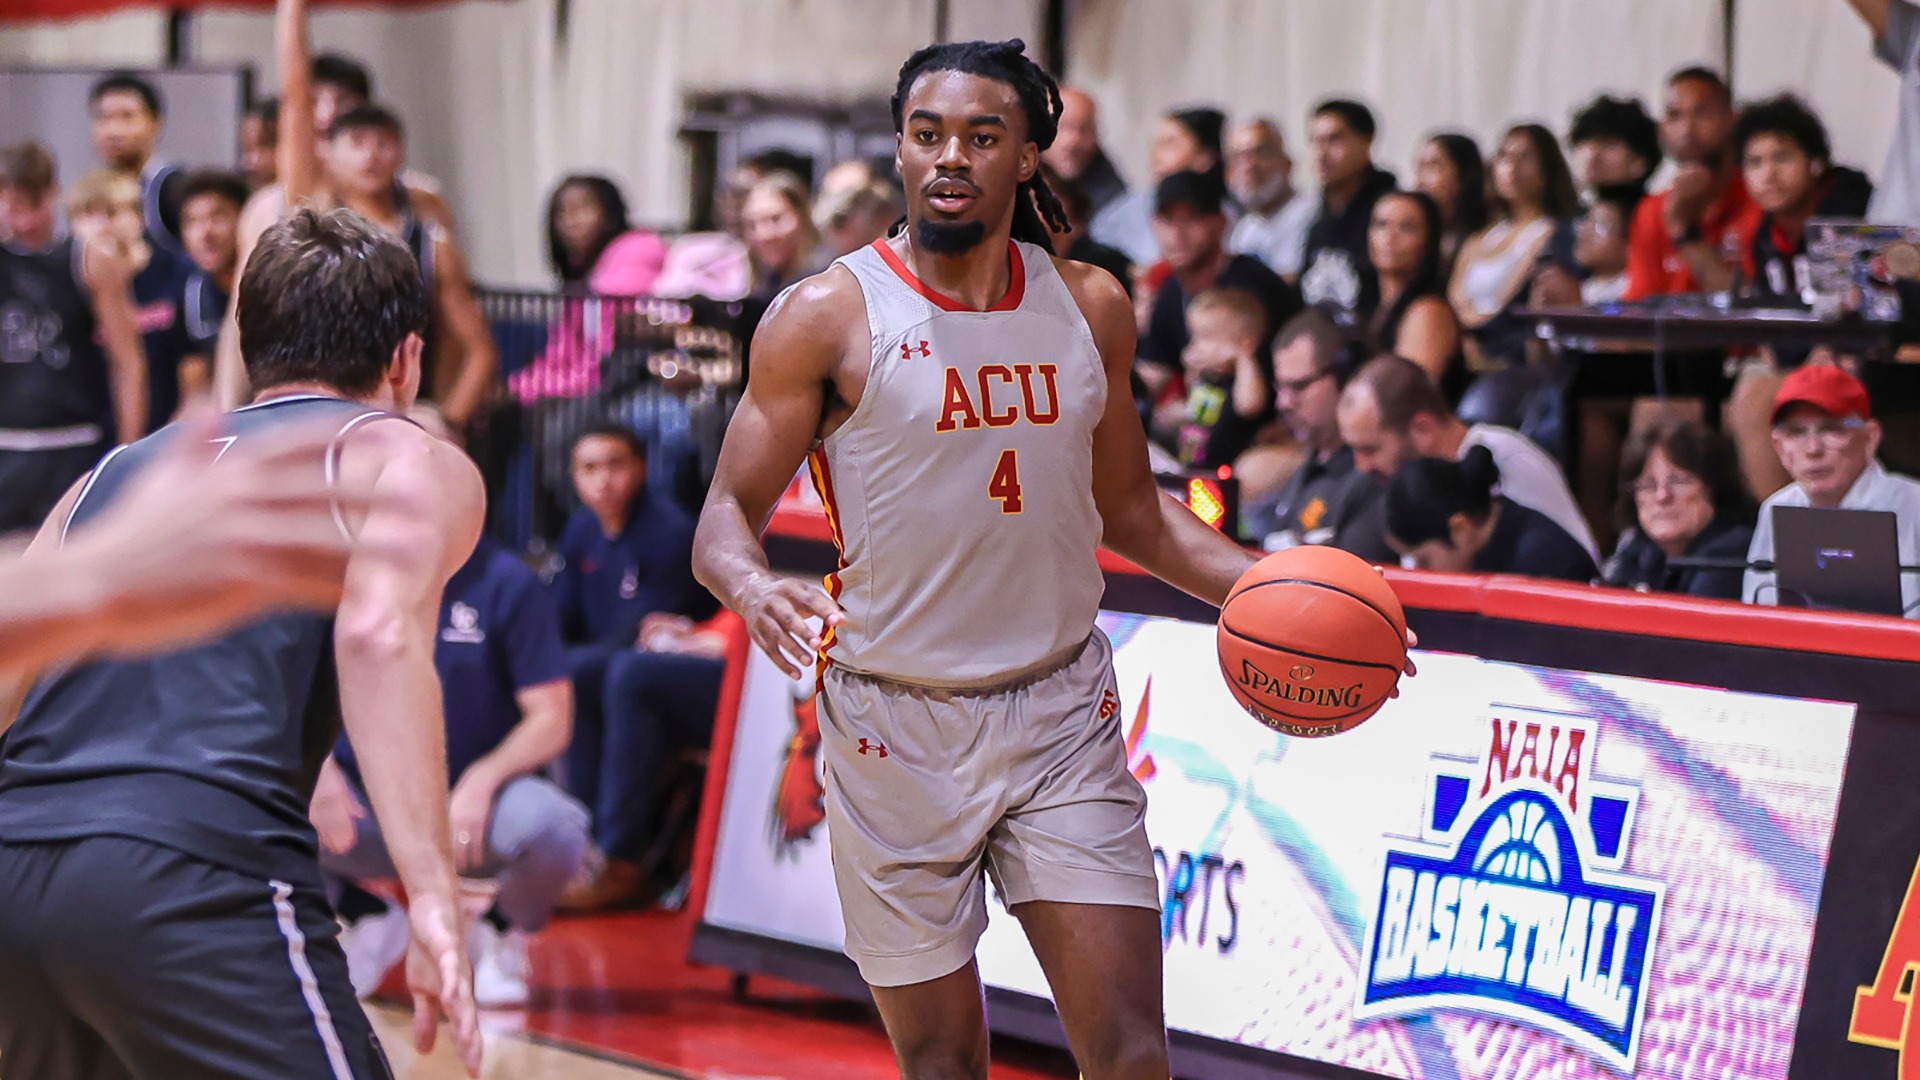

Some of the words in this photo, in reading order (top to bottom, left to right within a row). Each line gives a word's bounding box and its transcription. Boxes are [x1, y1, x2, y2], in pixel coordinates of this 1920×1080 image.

[935, 363, 1060, 433] ACU
[988, 448, 1023, 514] 4
[1238, 658, 1363, 708] SPALDING
[1479, 717, 1586, 815] NAIA
[1371, 865, 1638, 1032] BASKETBALL
